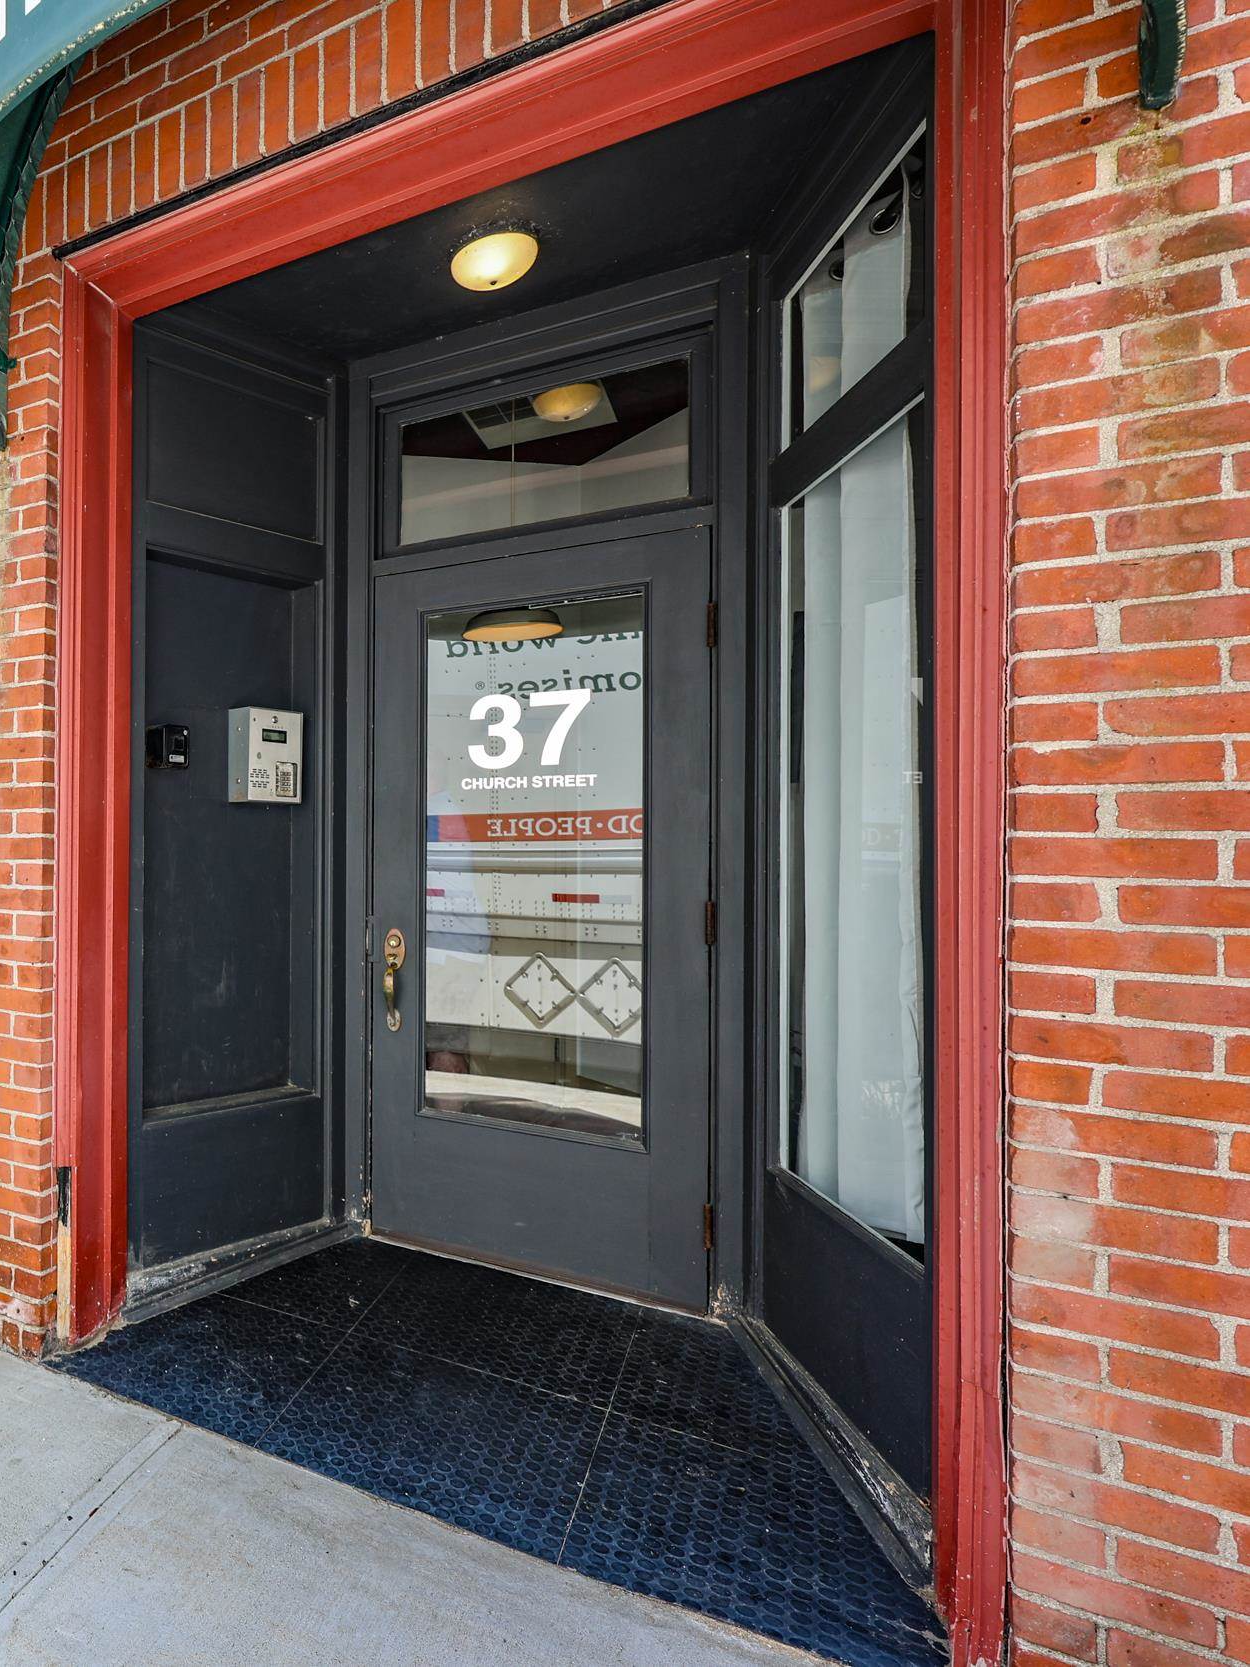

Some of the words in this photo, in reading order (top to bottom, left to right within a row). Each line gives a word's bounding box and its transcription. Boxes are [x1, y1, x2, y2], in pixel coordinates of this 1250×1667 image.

[467, 688, 591, 770] 37
[461, 776, 528, 790] CHURCH
[531, 773, 598, 789] STREET
